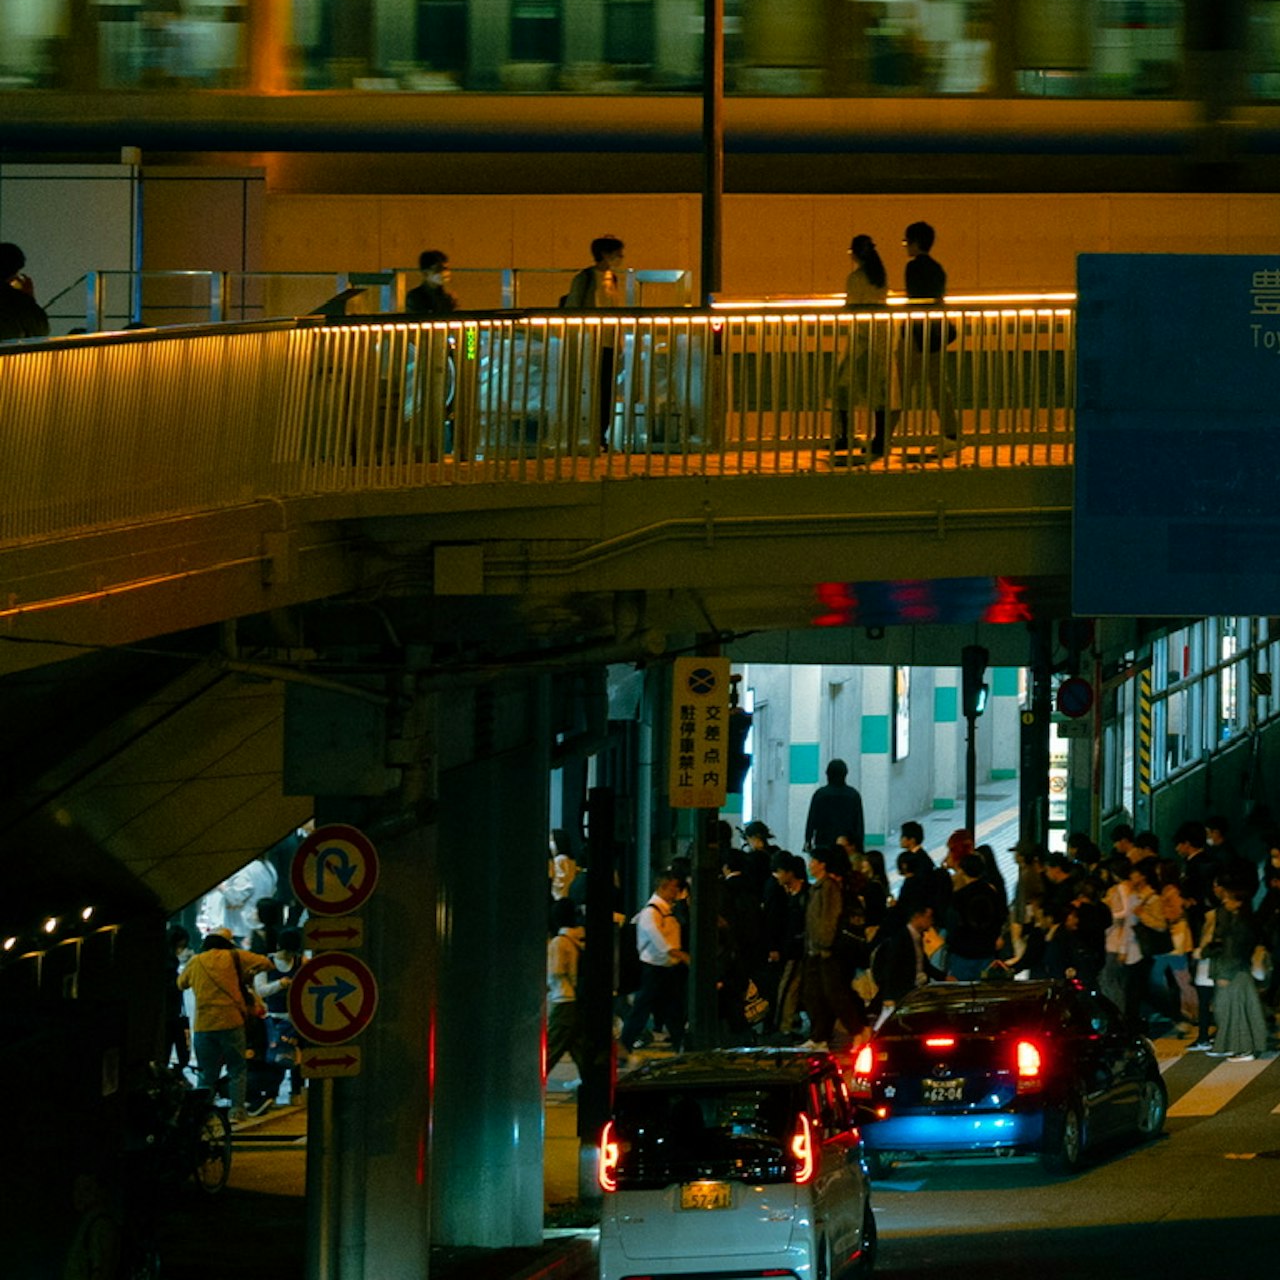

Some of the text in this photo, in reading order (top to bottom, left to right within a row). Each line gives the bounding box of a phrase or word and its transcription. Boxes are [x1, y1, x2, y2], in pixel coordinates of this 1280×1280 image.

[678, 704, 697, 788] 駐停車禁止
[702, 706, 721, 788] 交差点内
